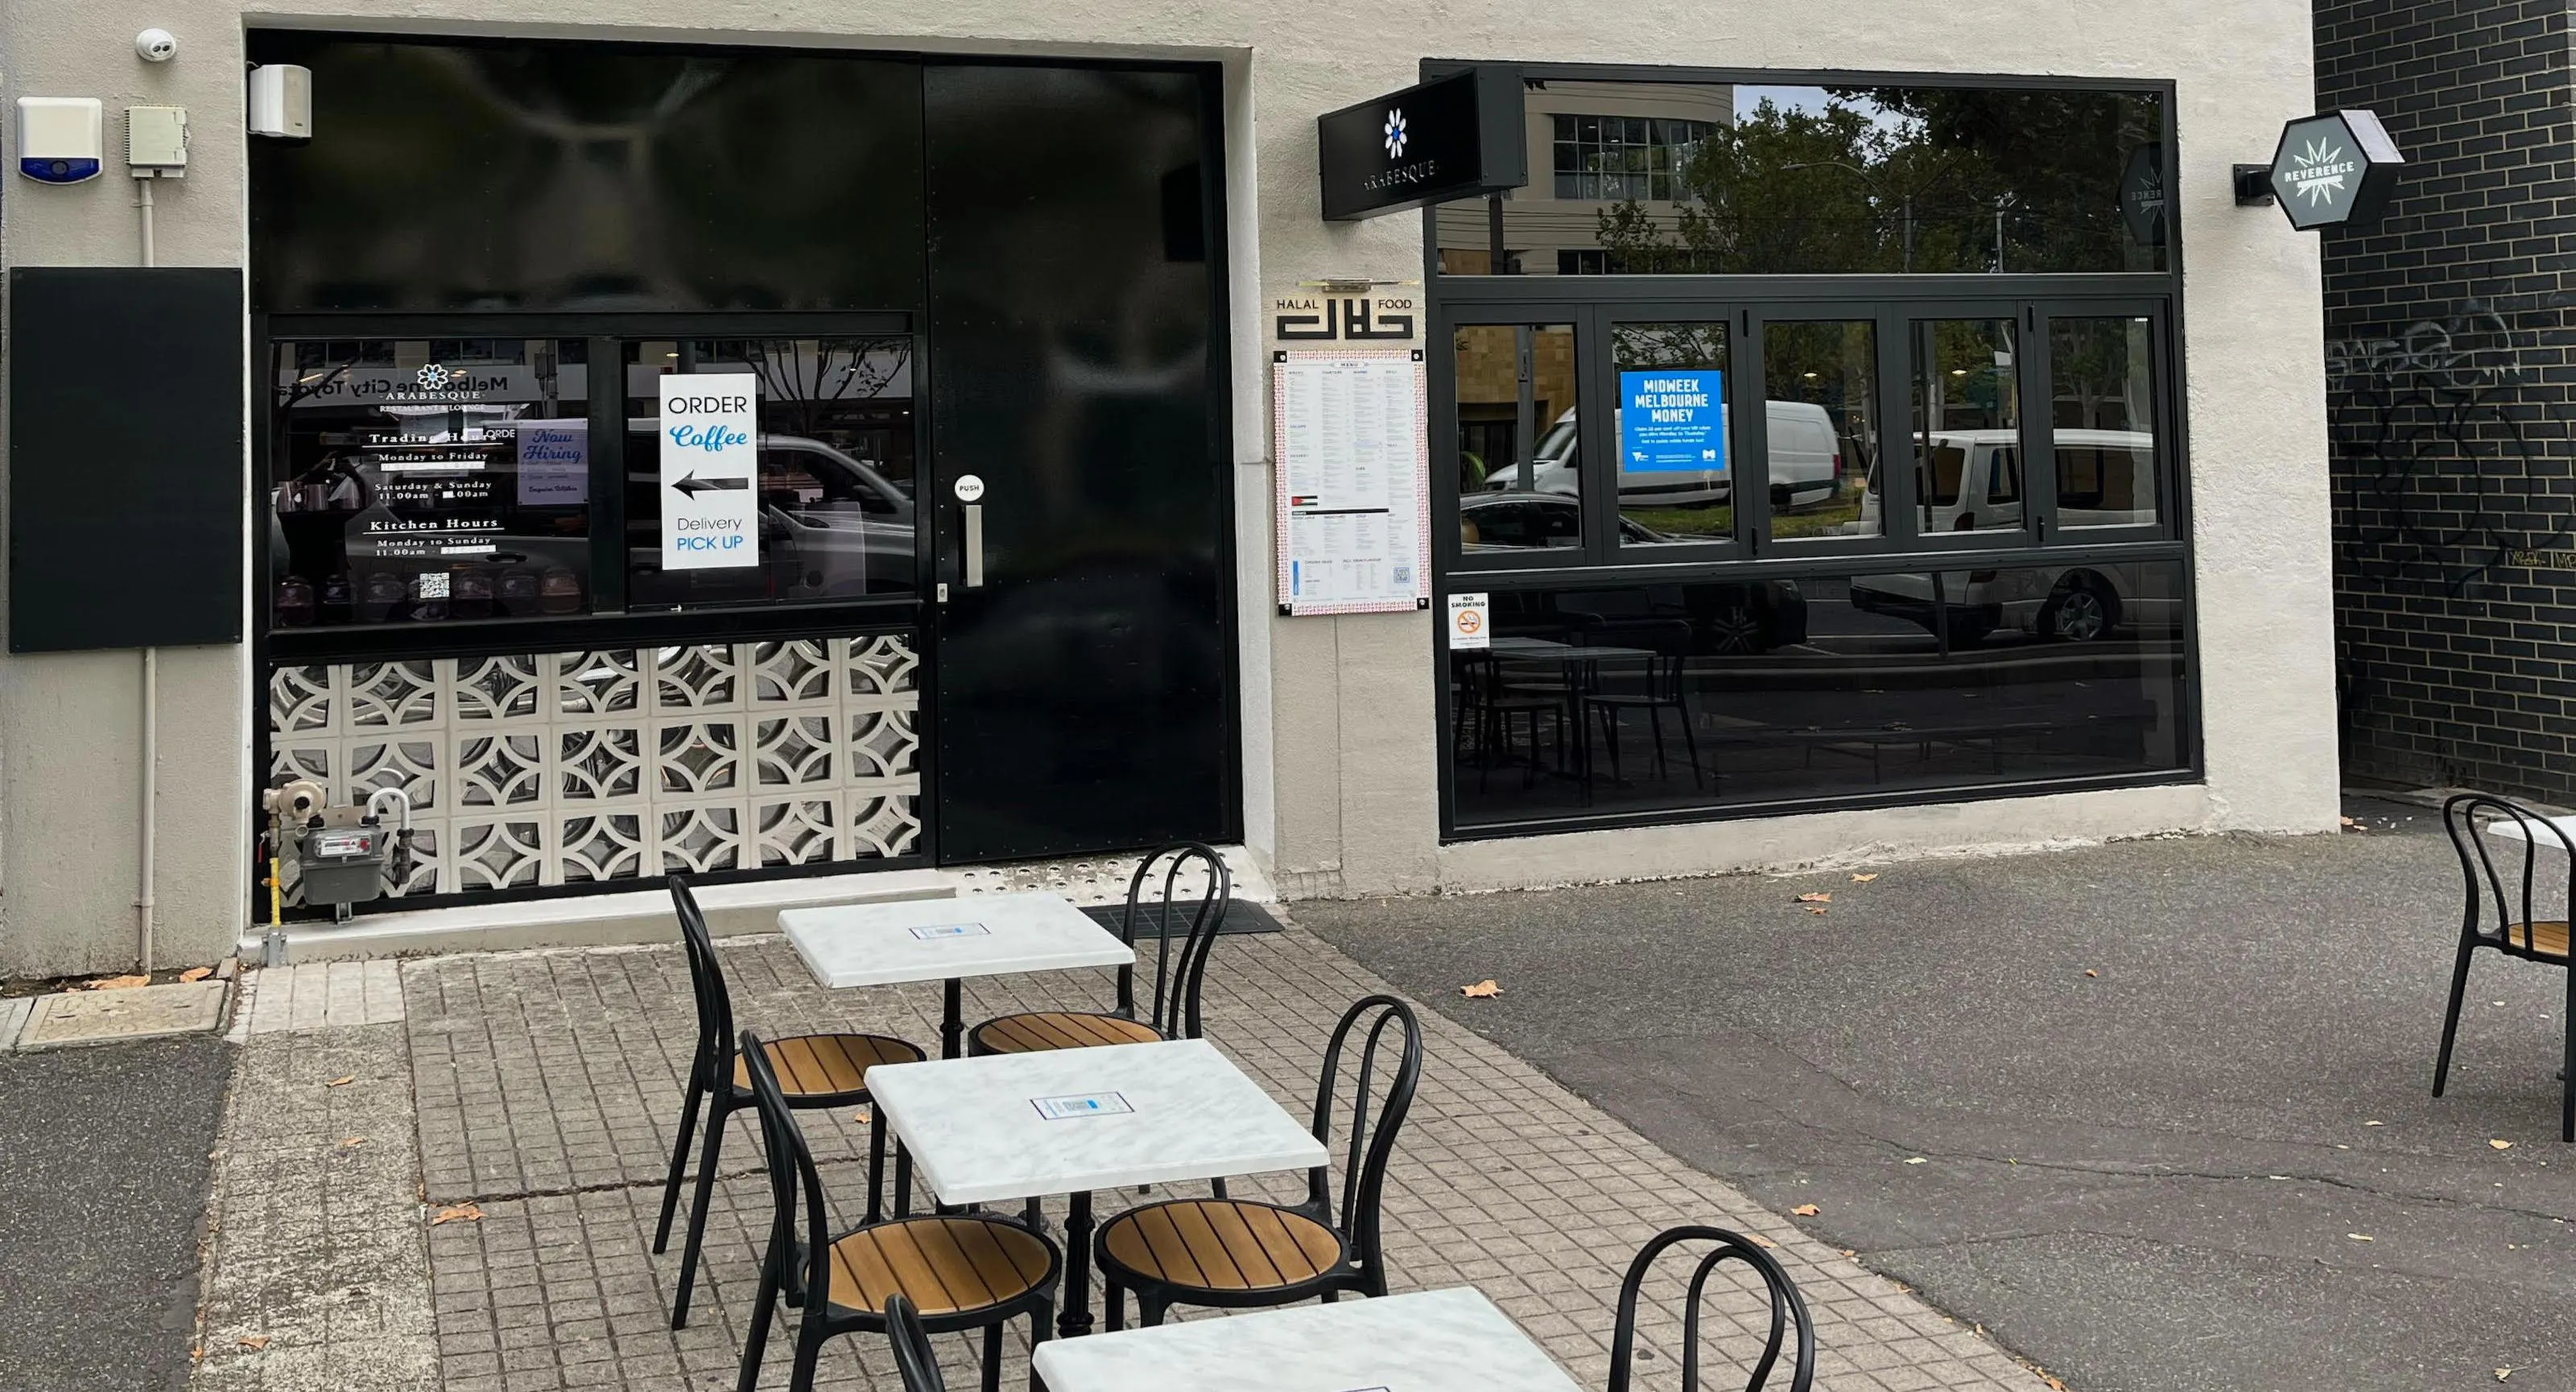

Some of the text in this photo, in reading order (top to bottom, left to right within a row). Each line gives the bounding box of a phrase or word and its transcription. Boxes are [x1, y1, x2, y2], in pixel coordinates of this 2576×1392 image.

[2284, 161, 2355, 183] REVERENCE
[1277, 299, 1412, 309] HALAL FOOD
[1644, 378, 1699, 393] MIDWEEK
[385, 391, 481, 401] ARABESQUE
[1635, 394, 1708, 408] MELBOURNE
[669, 396, 746, 414] ORDER
[1651, 409, 1694, 423] MONEY
[532, 428, 574, 443] Now
[669, 425, 748, 452] Coffee
[379, 453, 426, 461] Monday
[449, 452, 488, 461] Friday
[522, 445, 582, 464] Hiring
[374, 483, 428, 491] Saturday
[448, 481, 492, 489] Sunday
[370, 519, 497, 531] Kitchen Hours
[678, 518, 742, 531] Delivery
[377, 539, 425, 547] Monday
[677, 536, 744, 551] PICK UP
